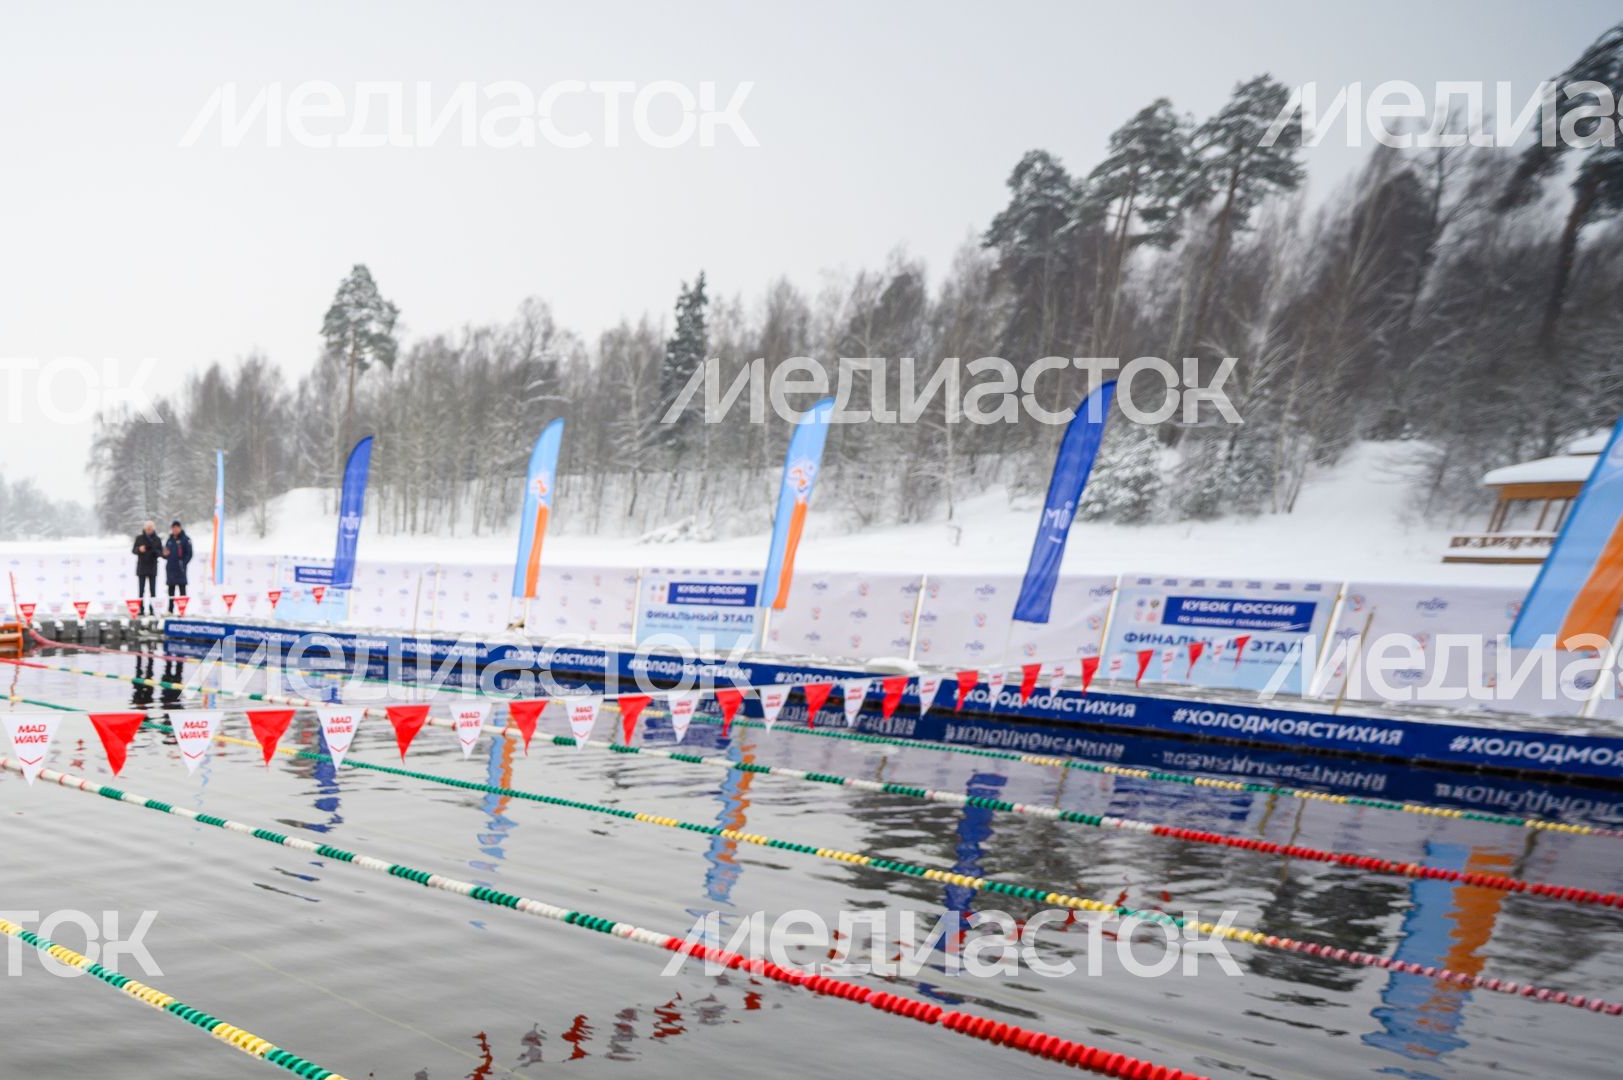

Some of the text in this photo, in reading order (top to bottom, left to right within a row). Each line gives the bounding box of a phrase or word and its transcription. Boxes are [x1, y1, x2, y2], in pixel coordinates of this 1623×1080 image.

[1181, 599, 1297, 617] КУБОК РОССИИ
[17, 724, 46, 734] MAD
[183, 720, 208, 730] MAD
[1172, 708, 1403, 746] #ХОЛОДМОЯСТИХИЯ
[14, 734, 49, 744] WAVE
[180, 730, 210, 739] WAVE
